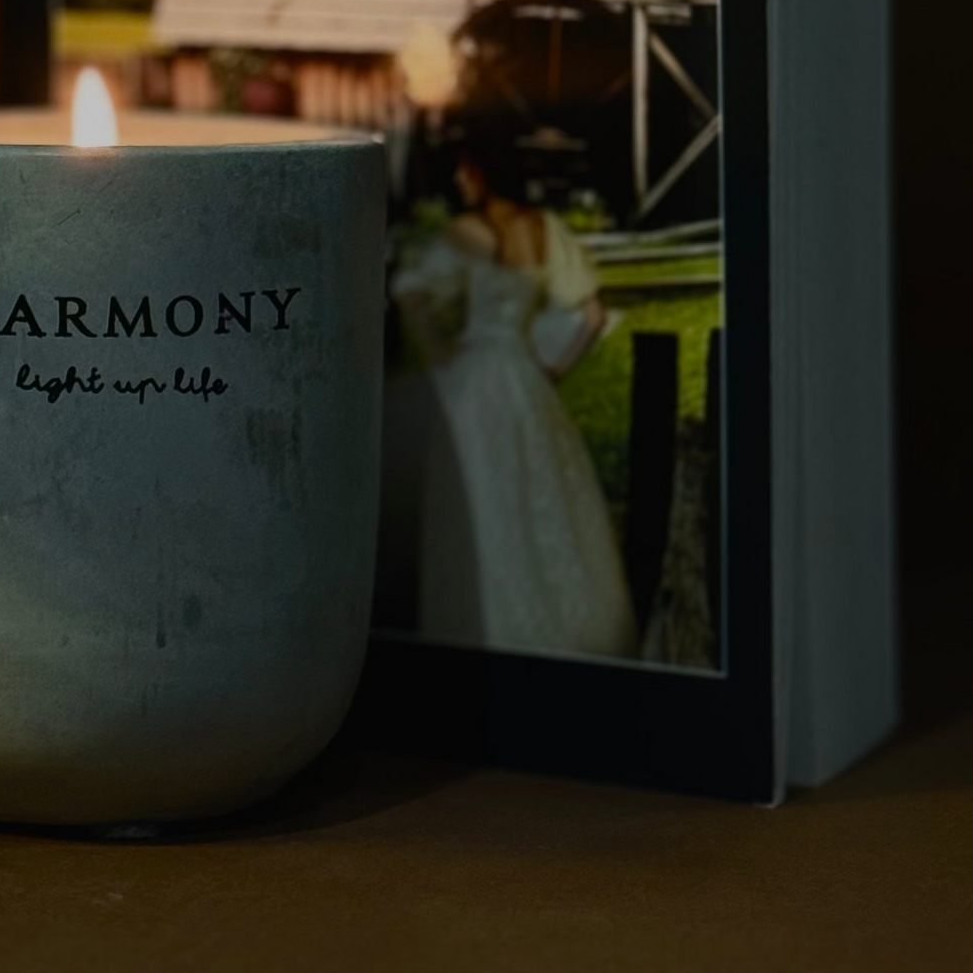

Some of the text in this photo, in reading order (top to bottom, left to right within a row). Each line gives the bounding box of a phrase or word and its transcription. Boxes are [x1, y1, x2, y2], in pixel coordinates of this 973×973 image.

[16, 364, 228, 404] light up life
